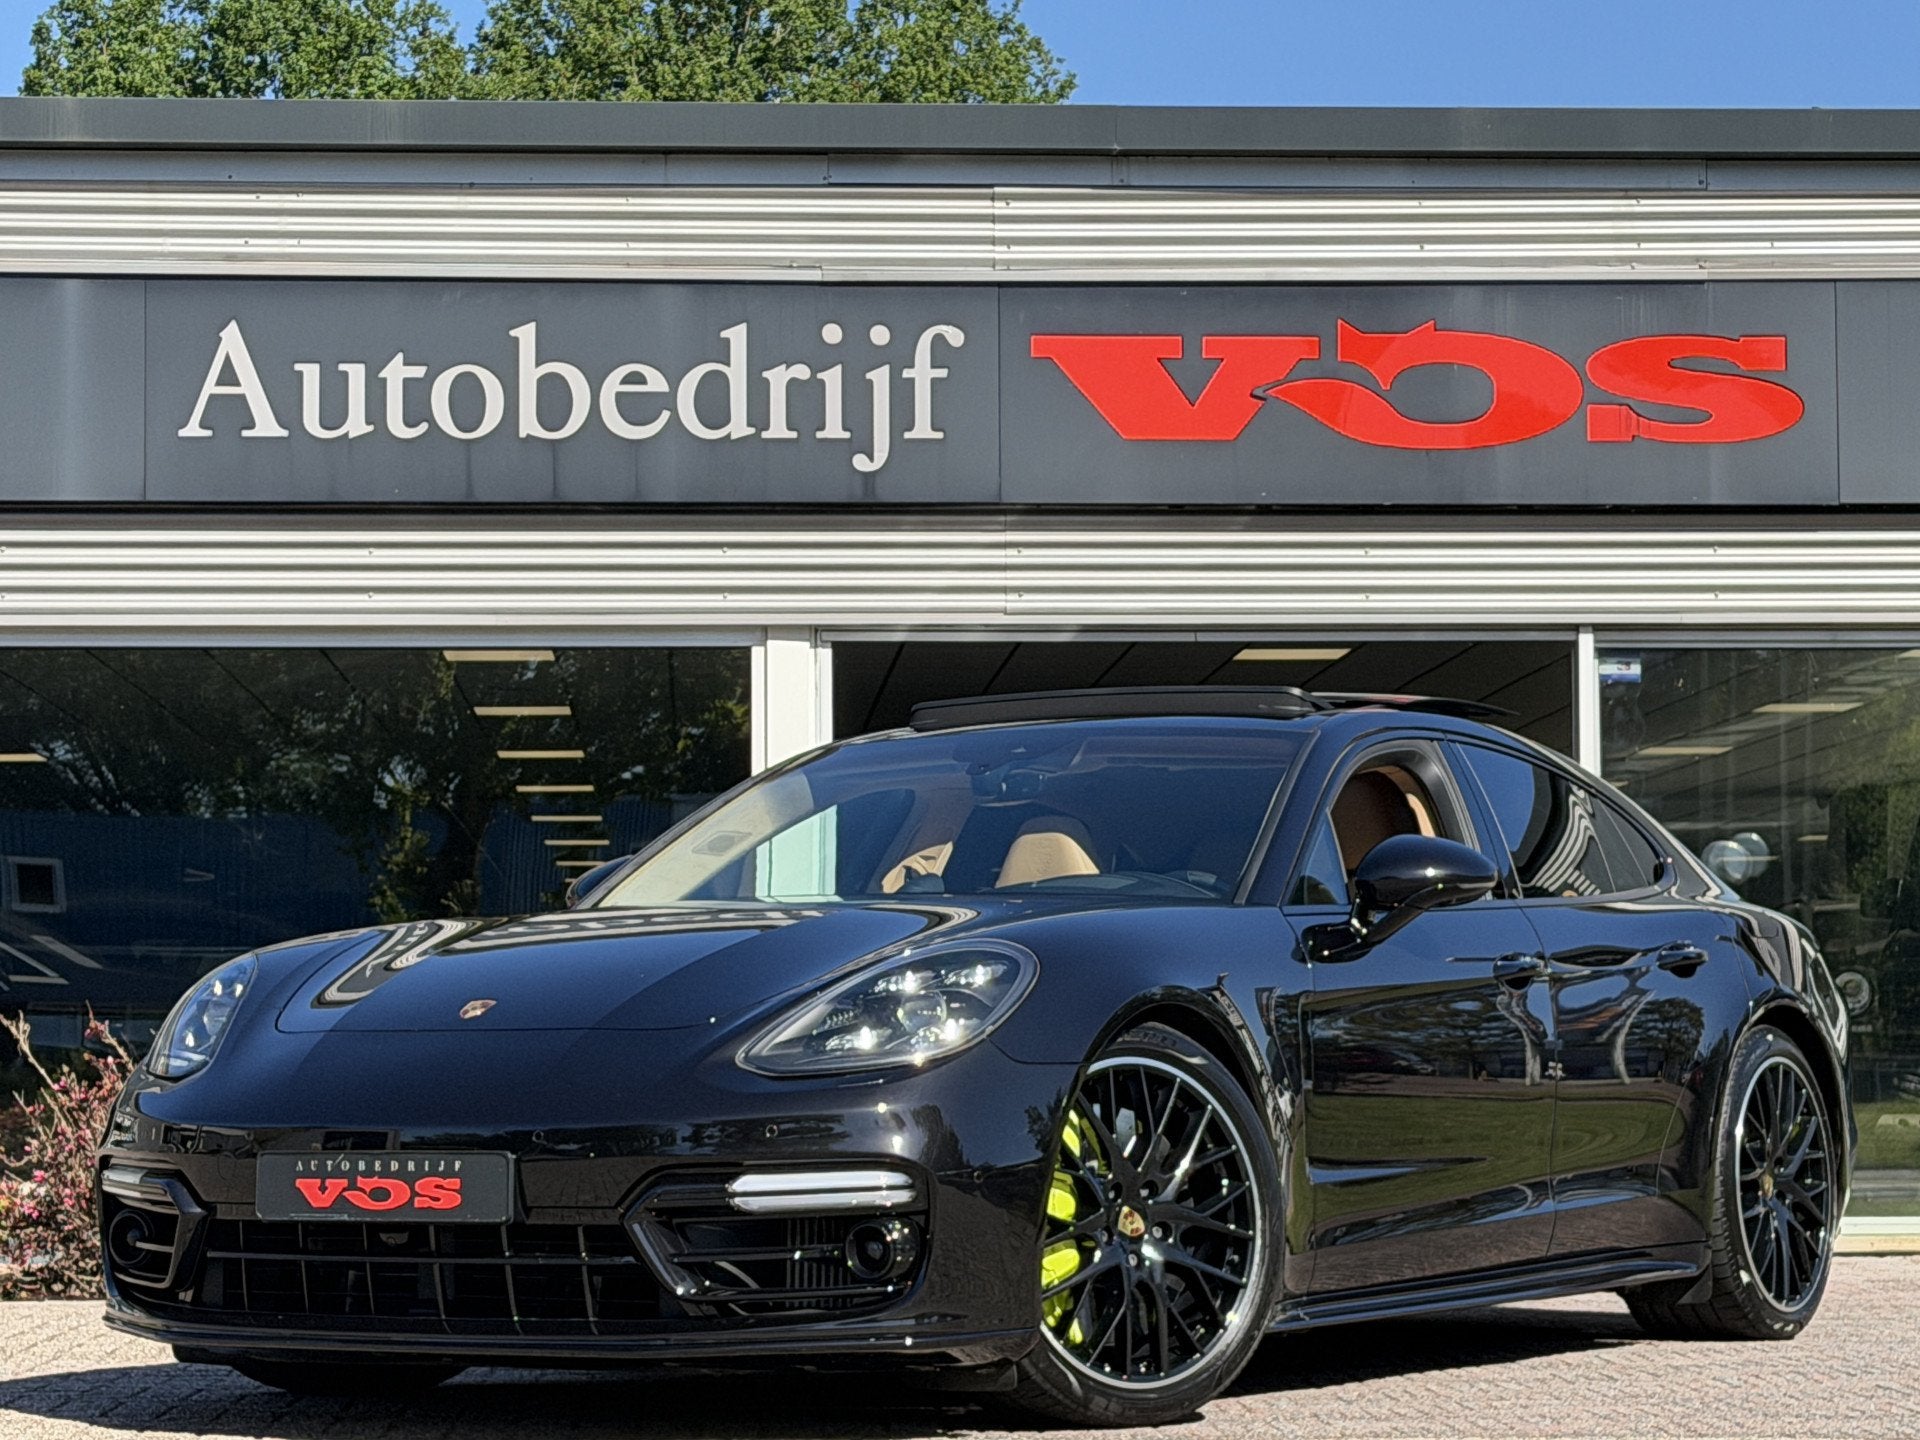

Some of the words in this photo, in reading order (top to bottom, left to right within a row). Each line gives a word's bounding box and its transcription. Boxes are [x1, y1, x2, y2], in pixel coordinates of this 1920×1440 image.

[177, 319, 966, 472] Autobedrijf
[1029, 319, 1806, 450] VOS
[296, 1159, 462, 1172] AUTOBEDRIJF
[295, 1176, 462, 1211] VOS
